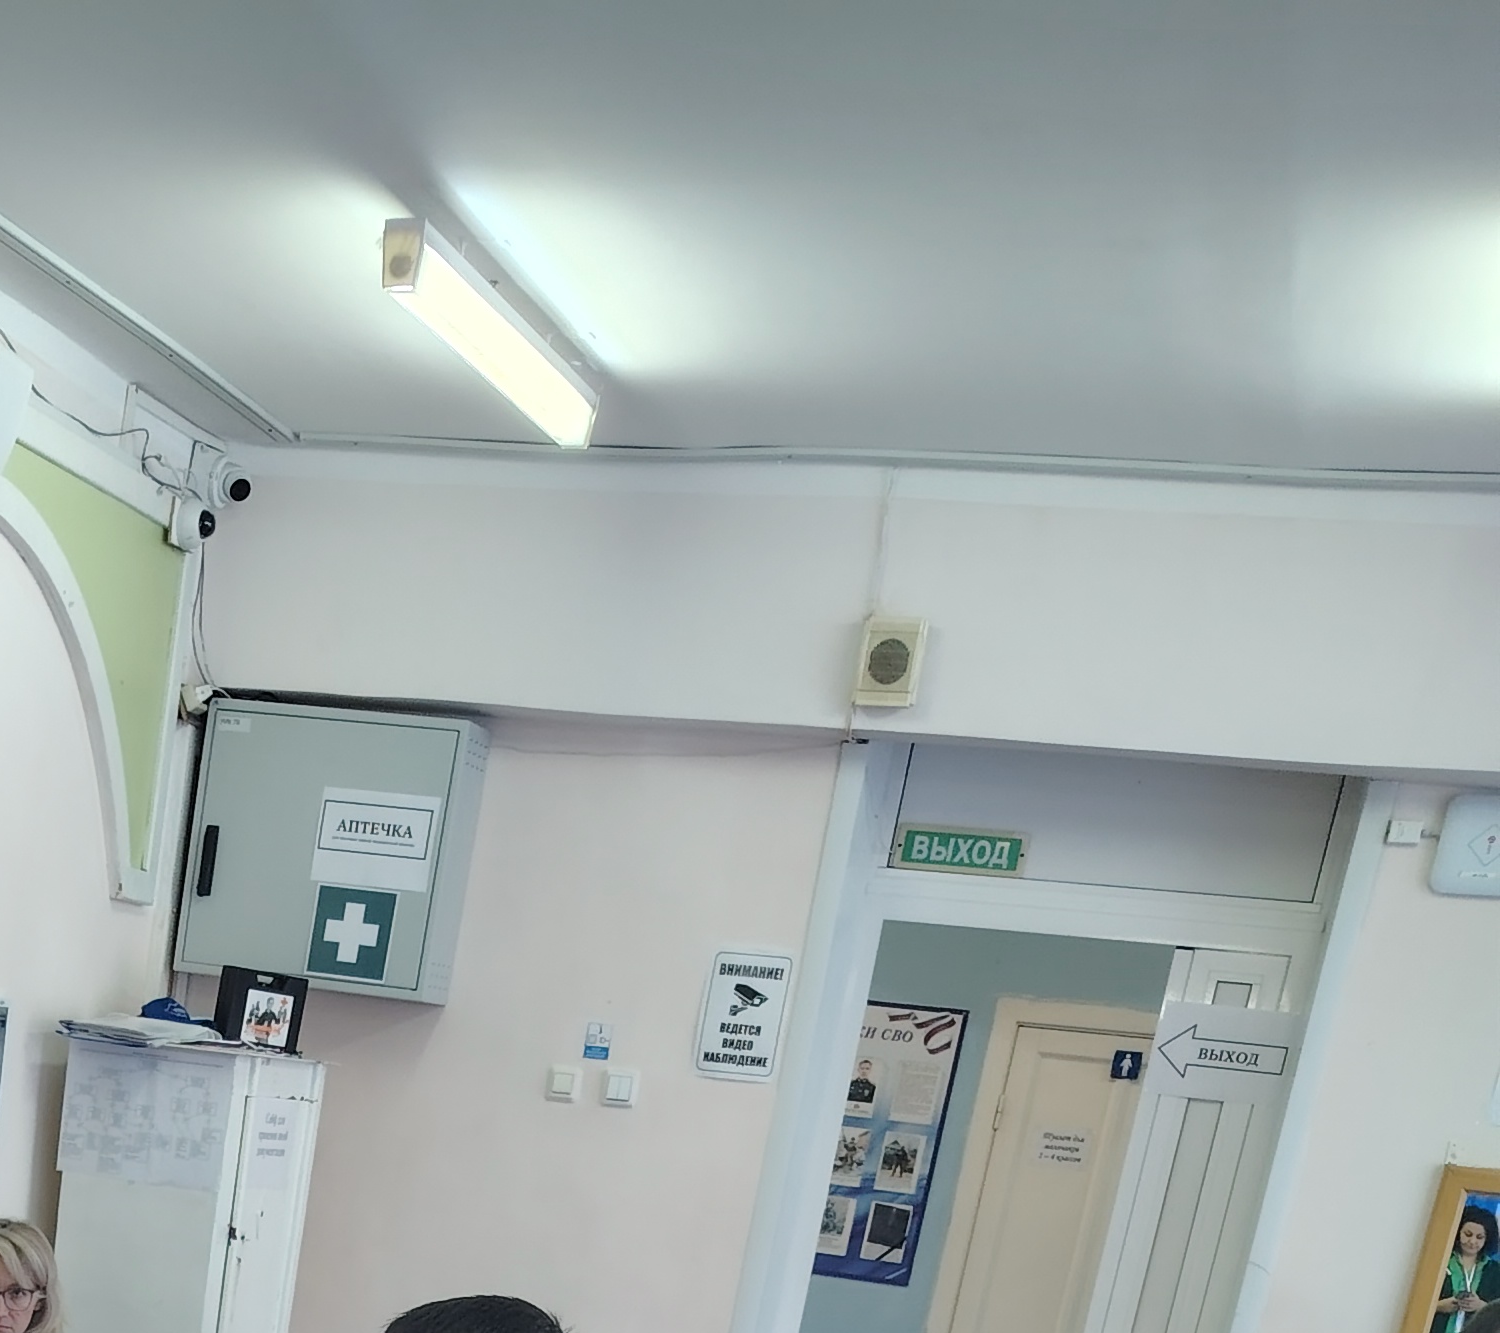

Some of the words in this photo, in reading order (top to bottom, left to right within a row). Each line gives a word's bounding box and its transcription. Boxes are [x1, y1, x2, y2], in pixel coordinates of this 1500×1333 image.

[336, 818, 413, 839] АПТЕЧКА
[910, 833, 1011, 870] ВЫХОД
[718, 962, 785, 982] ВНИМАНИЕ!
[719, 1022, 762, 1037] ВЕДЕТСЯ
[881, 1028, 914, 1043] СВО
[721, 1037, 754, 1052] ВИДЕО
[702, 1052, 769, 1069] НАБЛЮДЕНИЕ
[1197, 1045, 1261, 1069] ВЫХОД
